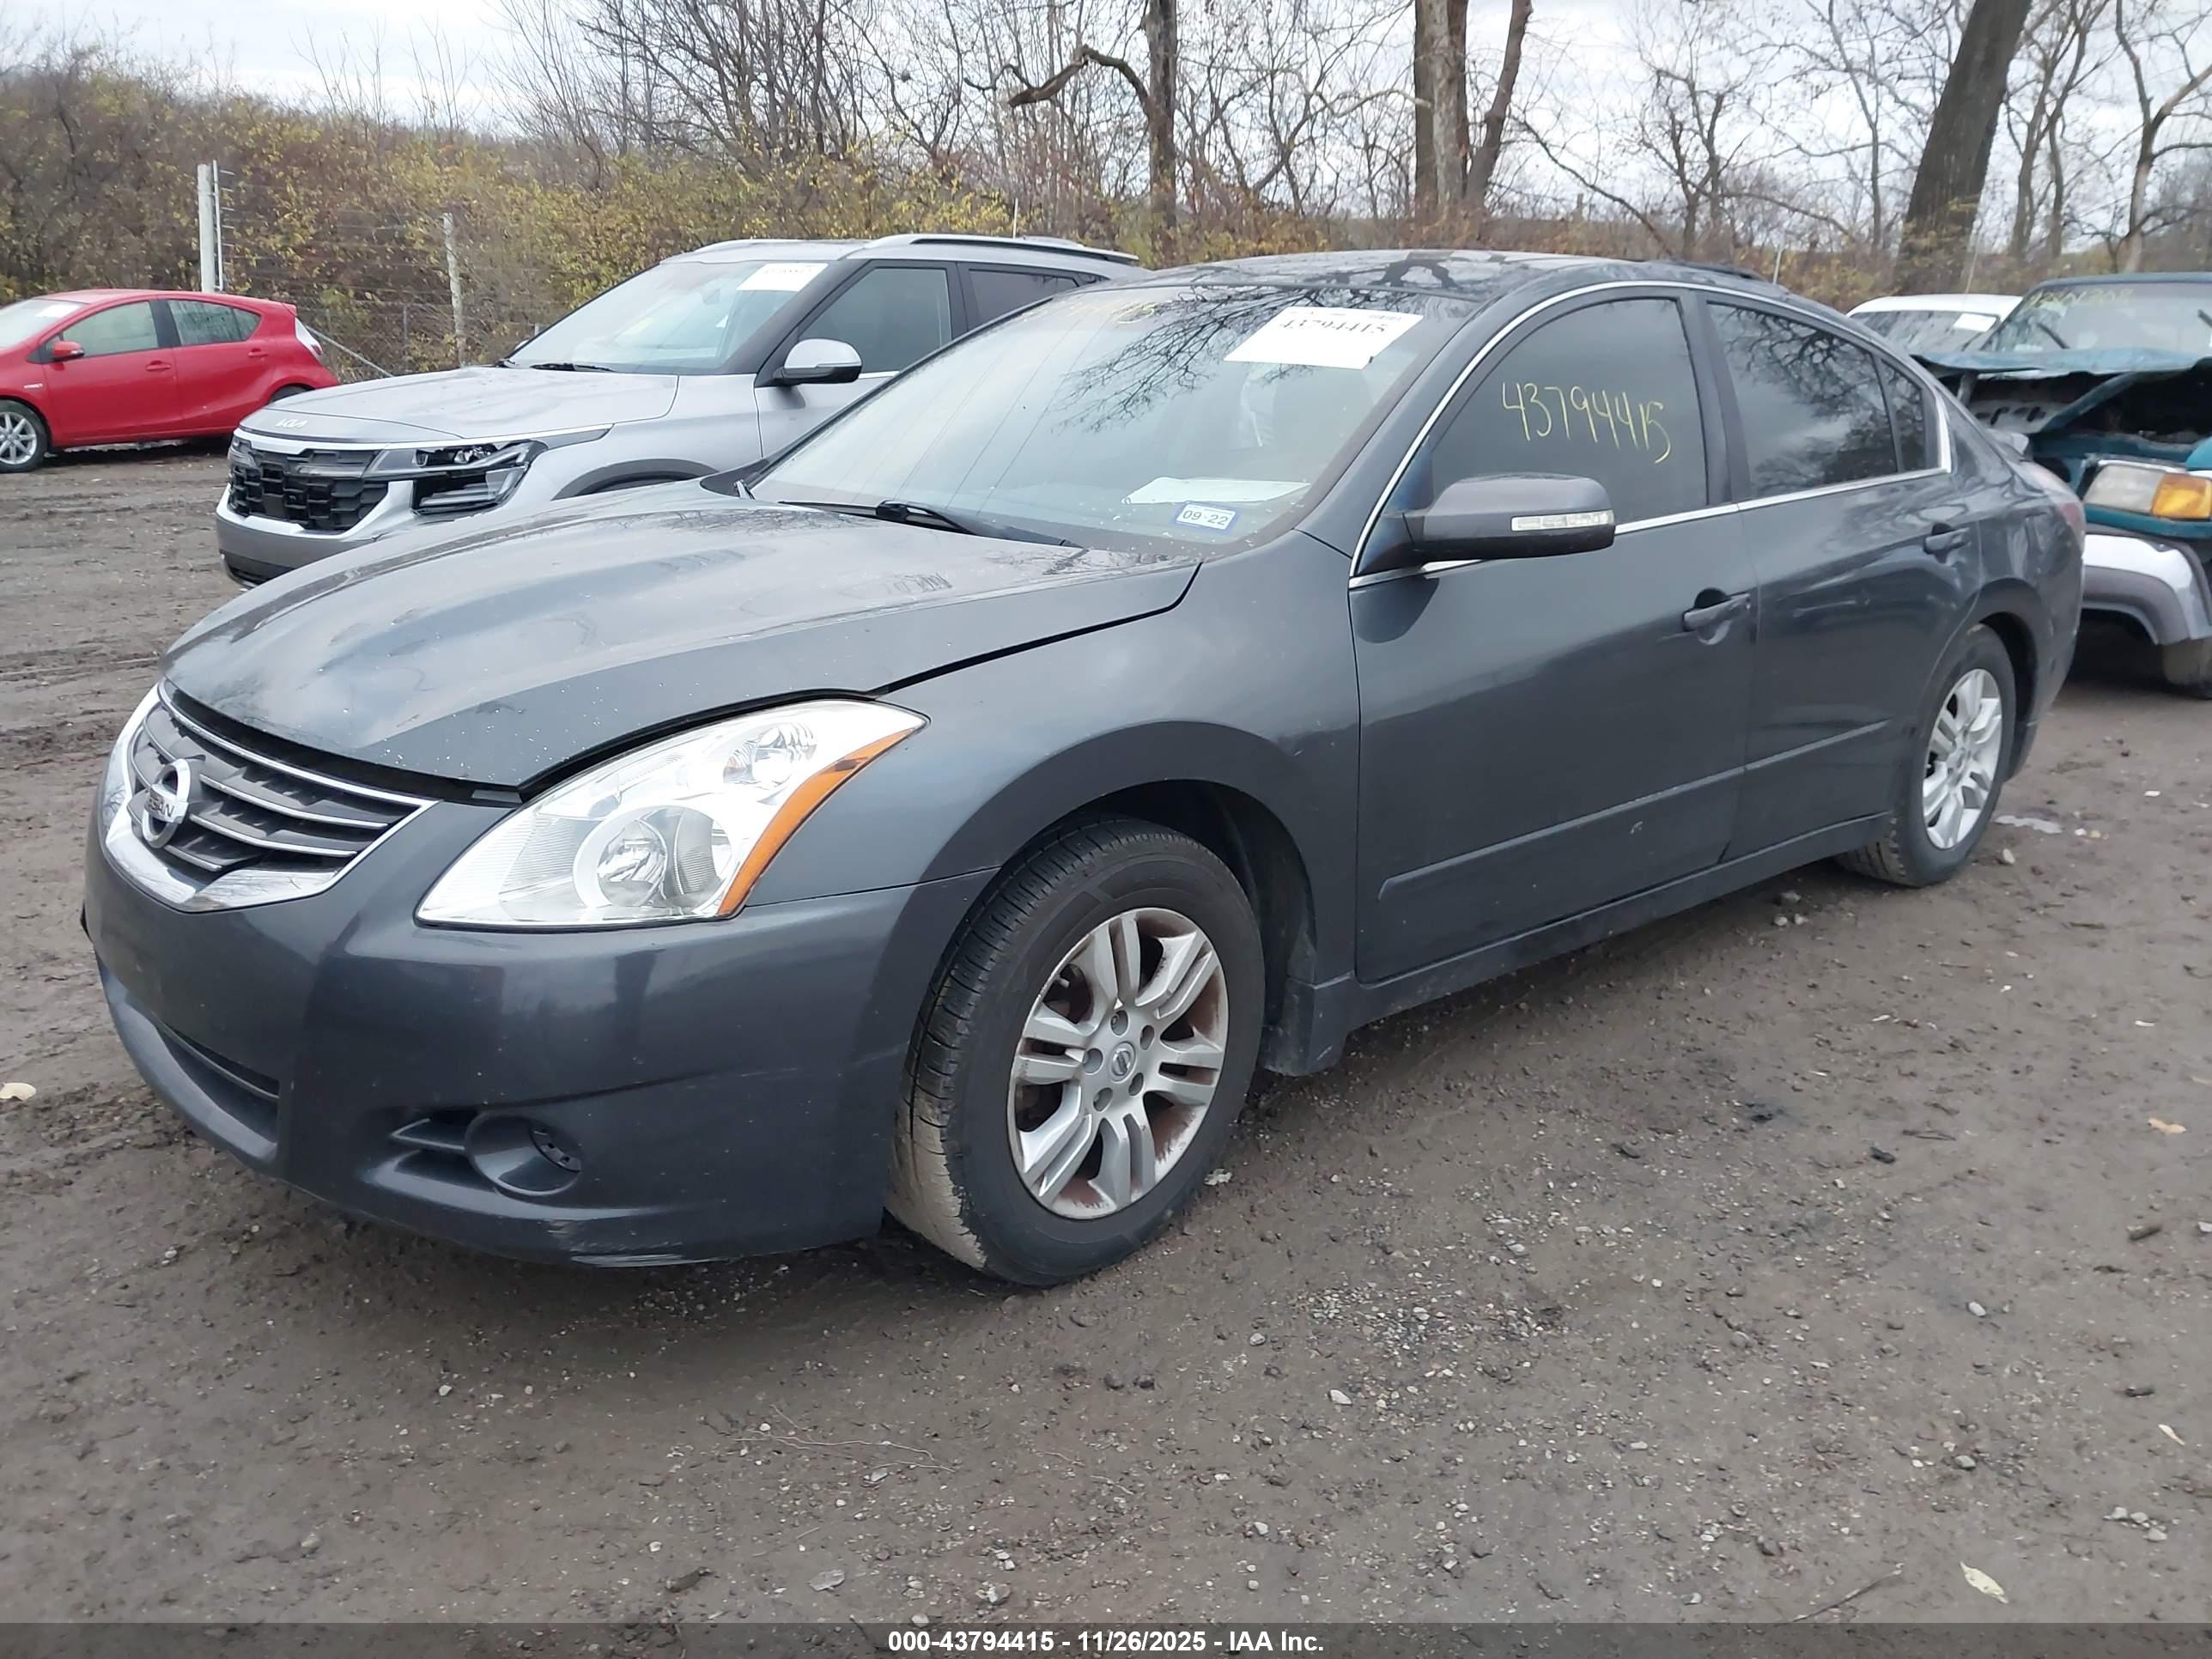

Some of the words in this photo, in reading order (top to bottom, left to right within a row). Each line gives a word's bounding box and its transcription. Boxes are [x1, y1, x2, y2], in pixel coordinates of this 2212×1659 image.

[1502, 382, 1672, 464] 43794415
[1182, 510, 1202, 520] 09
[1207, 514, 1229, 526] 22
